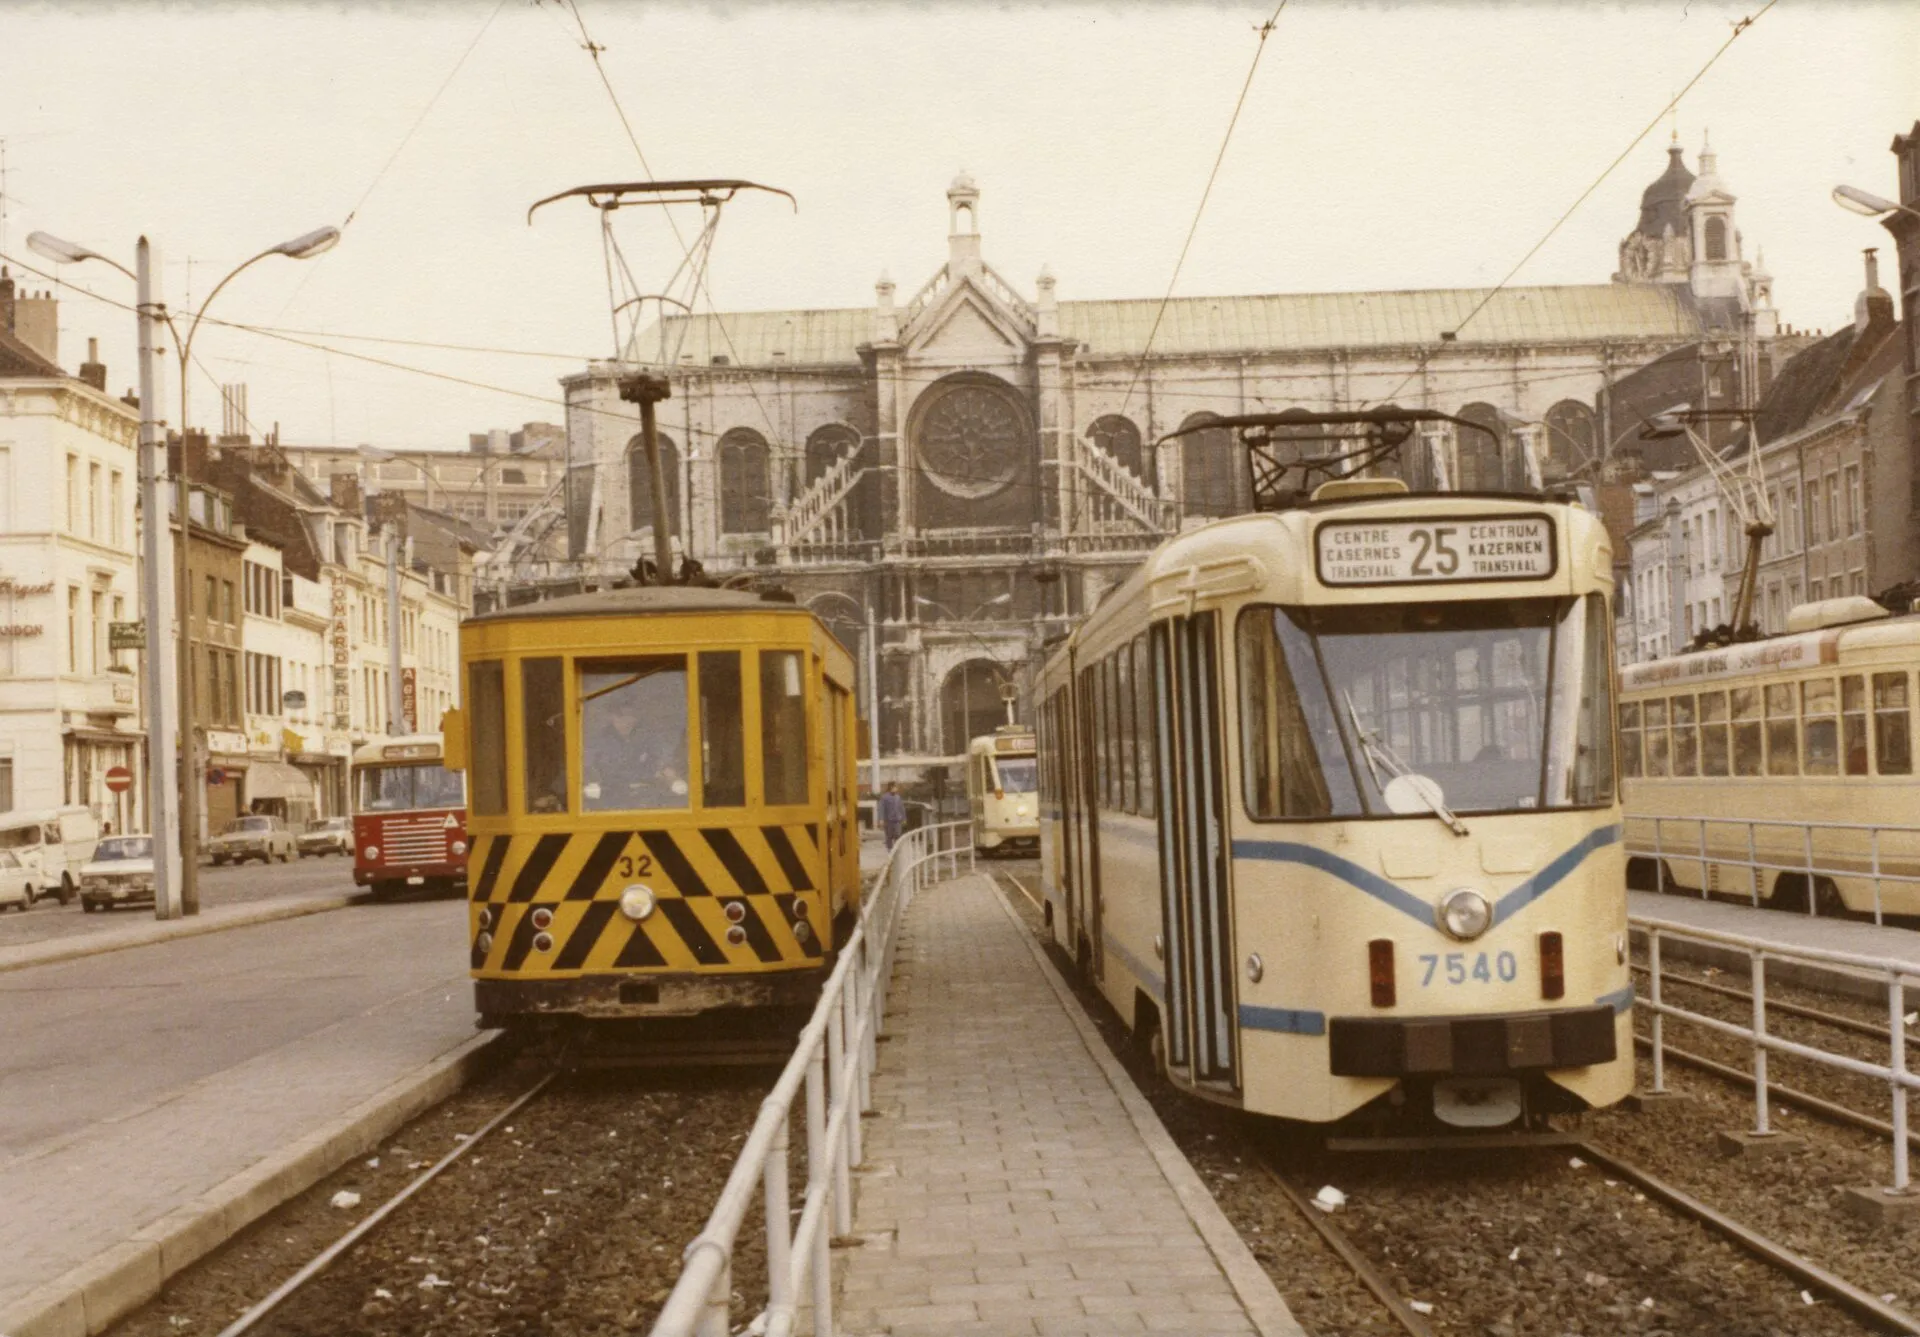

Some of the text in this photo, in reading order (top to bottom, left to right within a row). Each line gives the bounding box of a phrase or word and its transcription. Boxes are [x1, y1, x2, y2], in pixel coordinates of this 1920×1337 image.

[1334, 530, 1390, 544] CENTRE
[1470, 525, 1539, 539] CENTRUM
[1326, 547, 1401, 561] CASERNES
[1408, 527, 1459, 577] 25
[1468, 541, 1543, 556] KAZERNEN
[1331, 564, 1397, 578] TRANSVAAL
[1472, 560, 1538, 573] TRANSVAAL
[620, 854, 652, 878] 32
[1418, 951, 1516, 987] 7540
